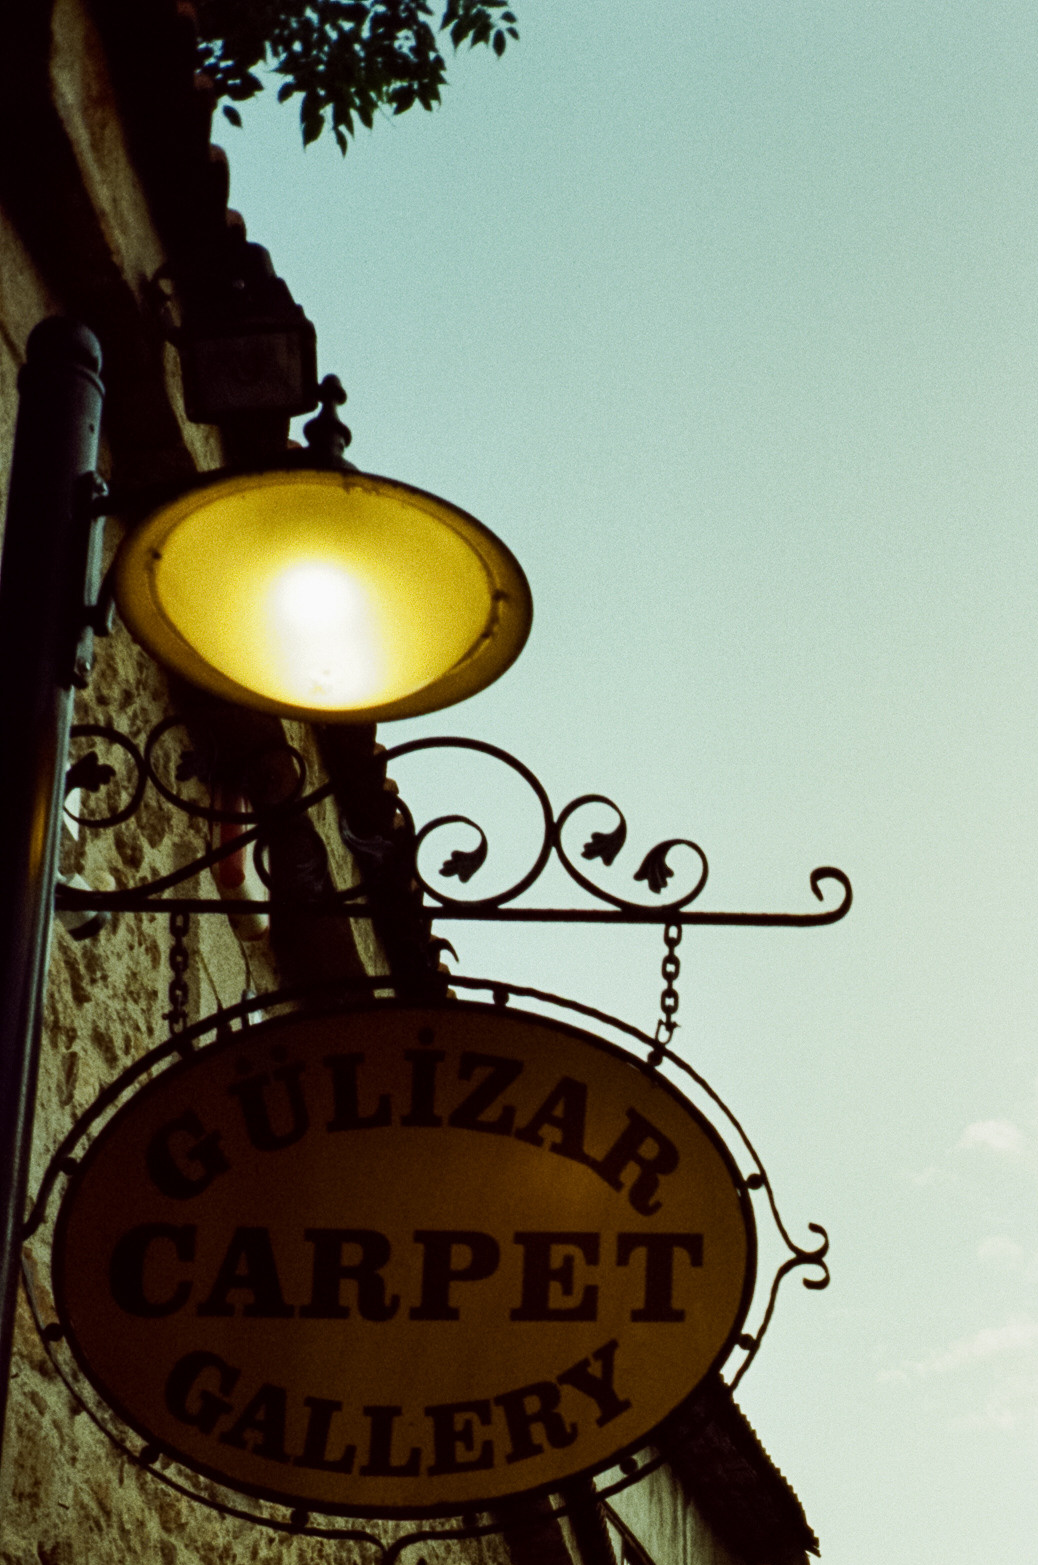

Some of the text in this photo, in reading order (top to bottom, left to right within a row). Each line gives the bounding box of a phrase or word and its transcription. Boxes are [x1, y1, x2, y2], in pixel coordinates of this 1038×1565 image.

[145, 1027, 682, 1217] GÜLİZAR
[108, 1221, 704, 1324] CARPET
[163, 1338, 634, 1478] GALLERY
